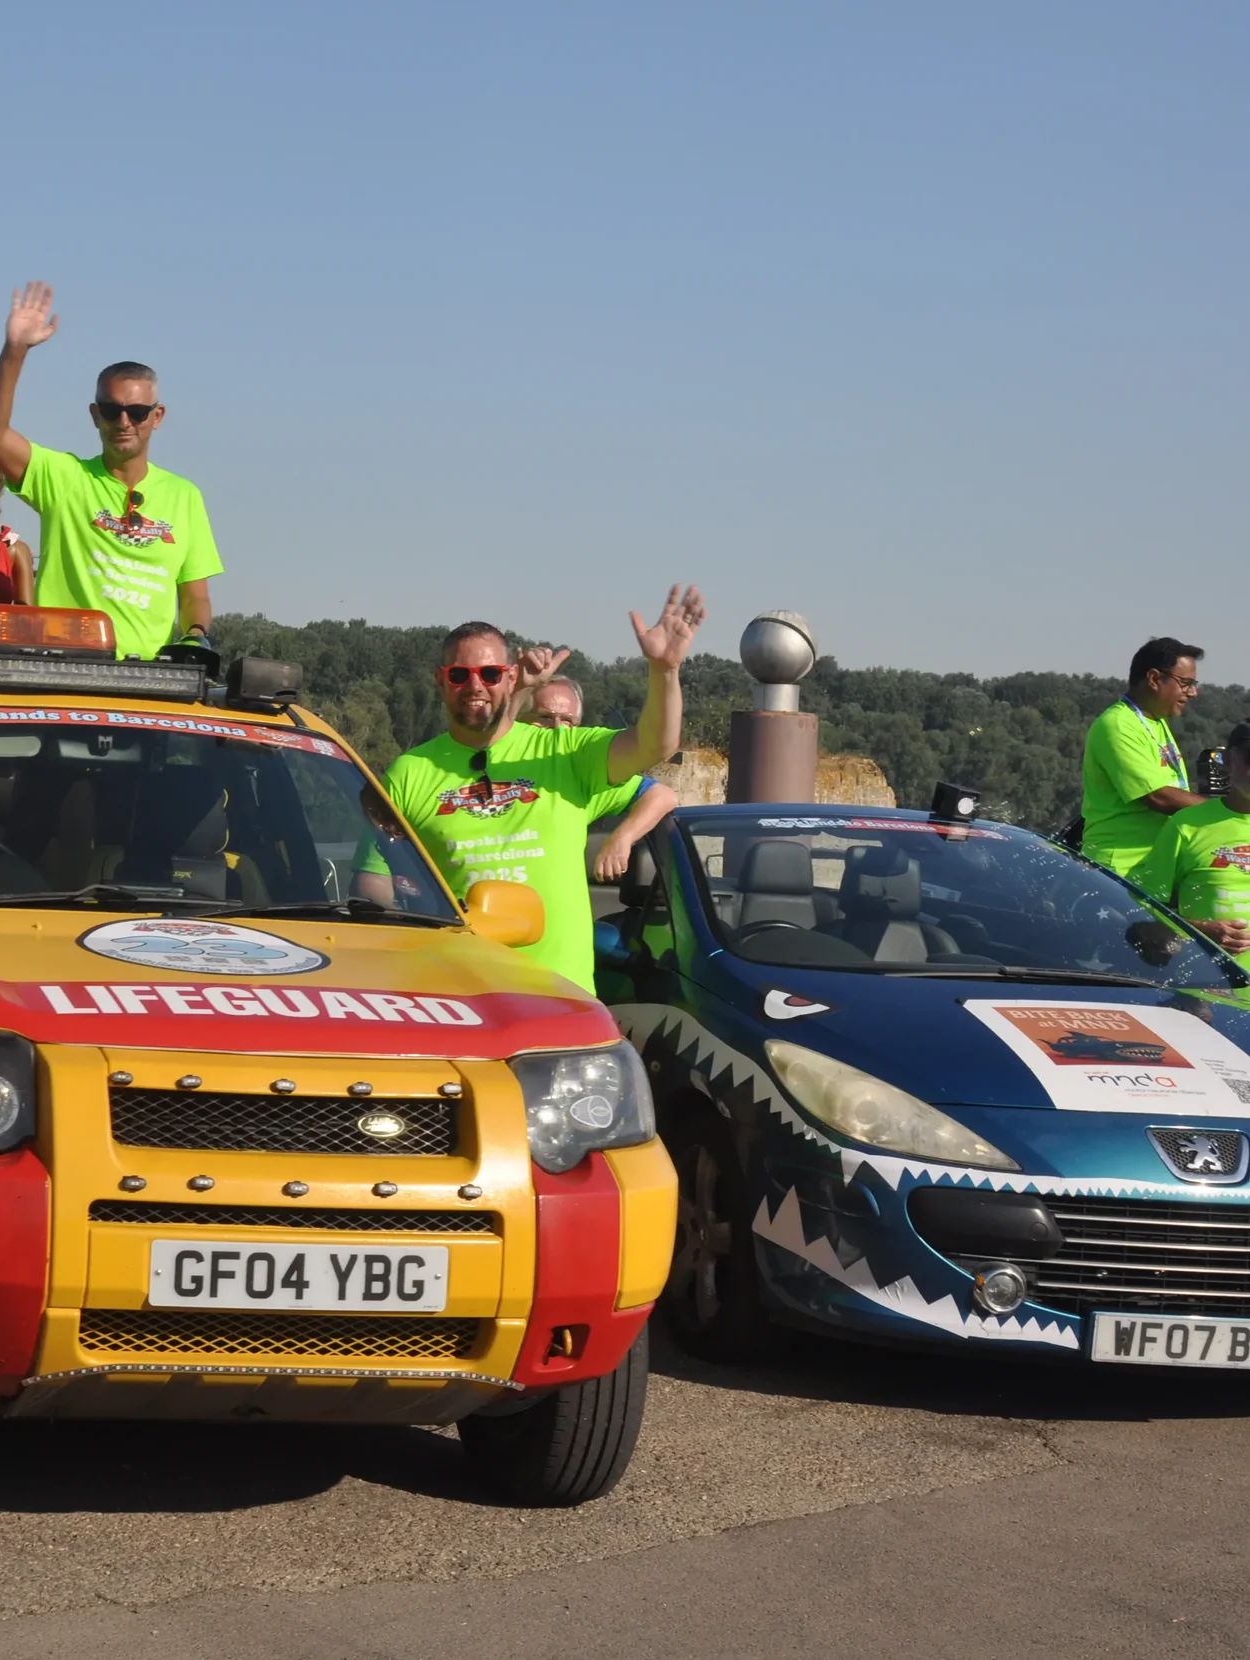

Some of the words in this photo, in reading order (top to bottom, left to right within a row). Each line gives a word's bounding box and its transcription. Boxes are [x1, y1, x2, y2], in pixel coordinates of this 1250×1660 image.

[102, 584, 151, 609] 2025
[67, 711, 99, 722] to
[105, 711, 248, 737] Barcelona
[493, 789, 522, 802] Rally
[111, 935, 289, 960] 23
[39, 985, 484, 1026] LIFEGUARD
[1006, 1010, 1066, 1019] BITE
[1066, 1011, 1130, 1021] BACK
[1038, 1020, 1058, 1028] at
[1057, 1020, 1130, 1031] MND
[1087, 1073, 1178, 1088] mnda
[173, 1249, 310, 1300] GF04
[329, 1253, 426, 1302] YBG
[1114, 1320, 1217, 1361] WF07
[1227, 1326, 1250, 1362] B
